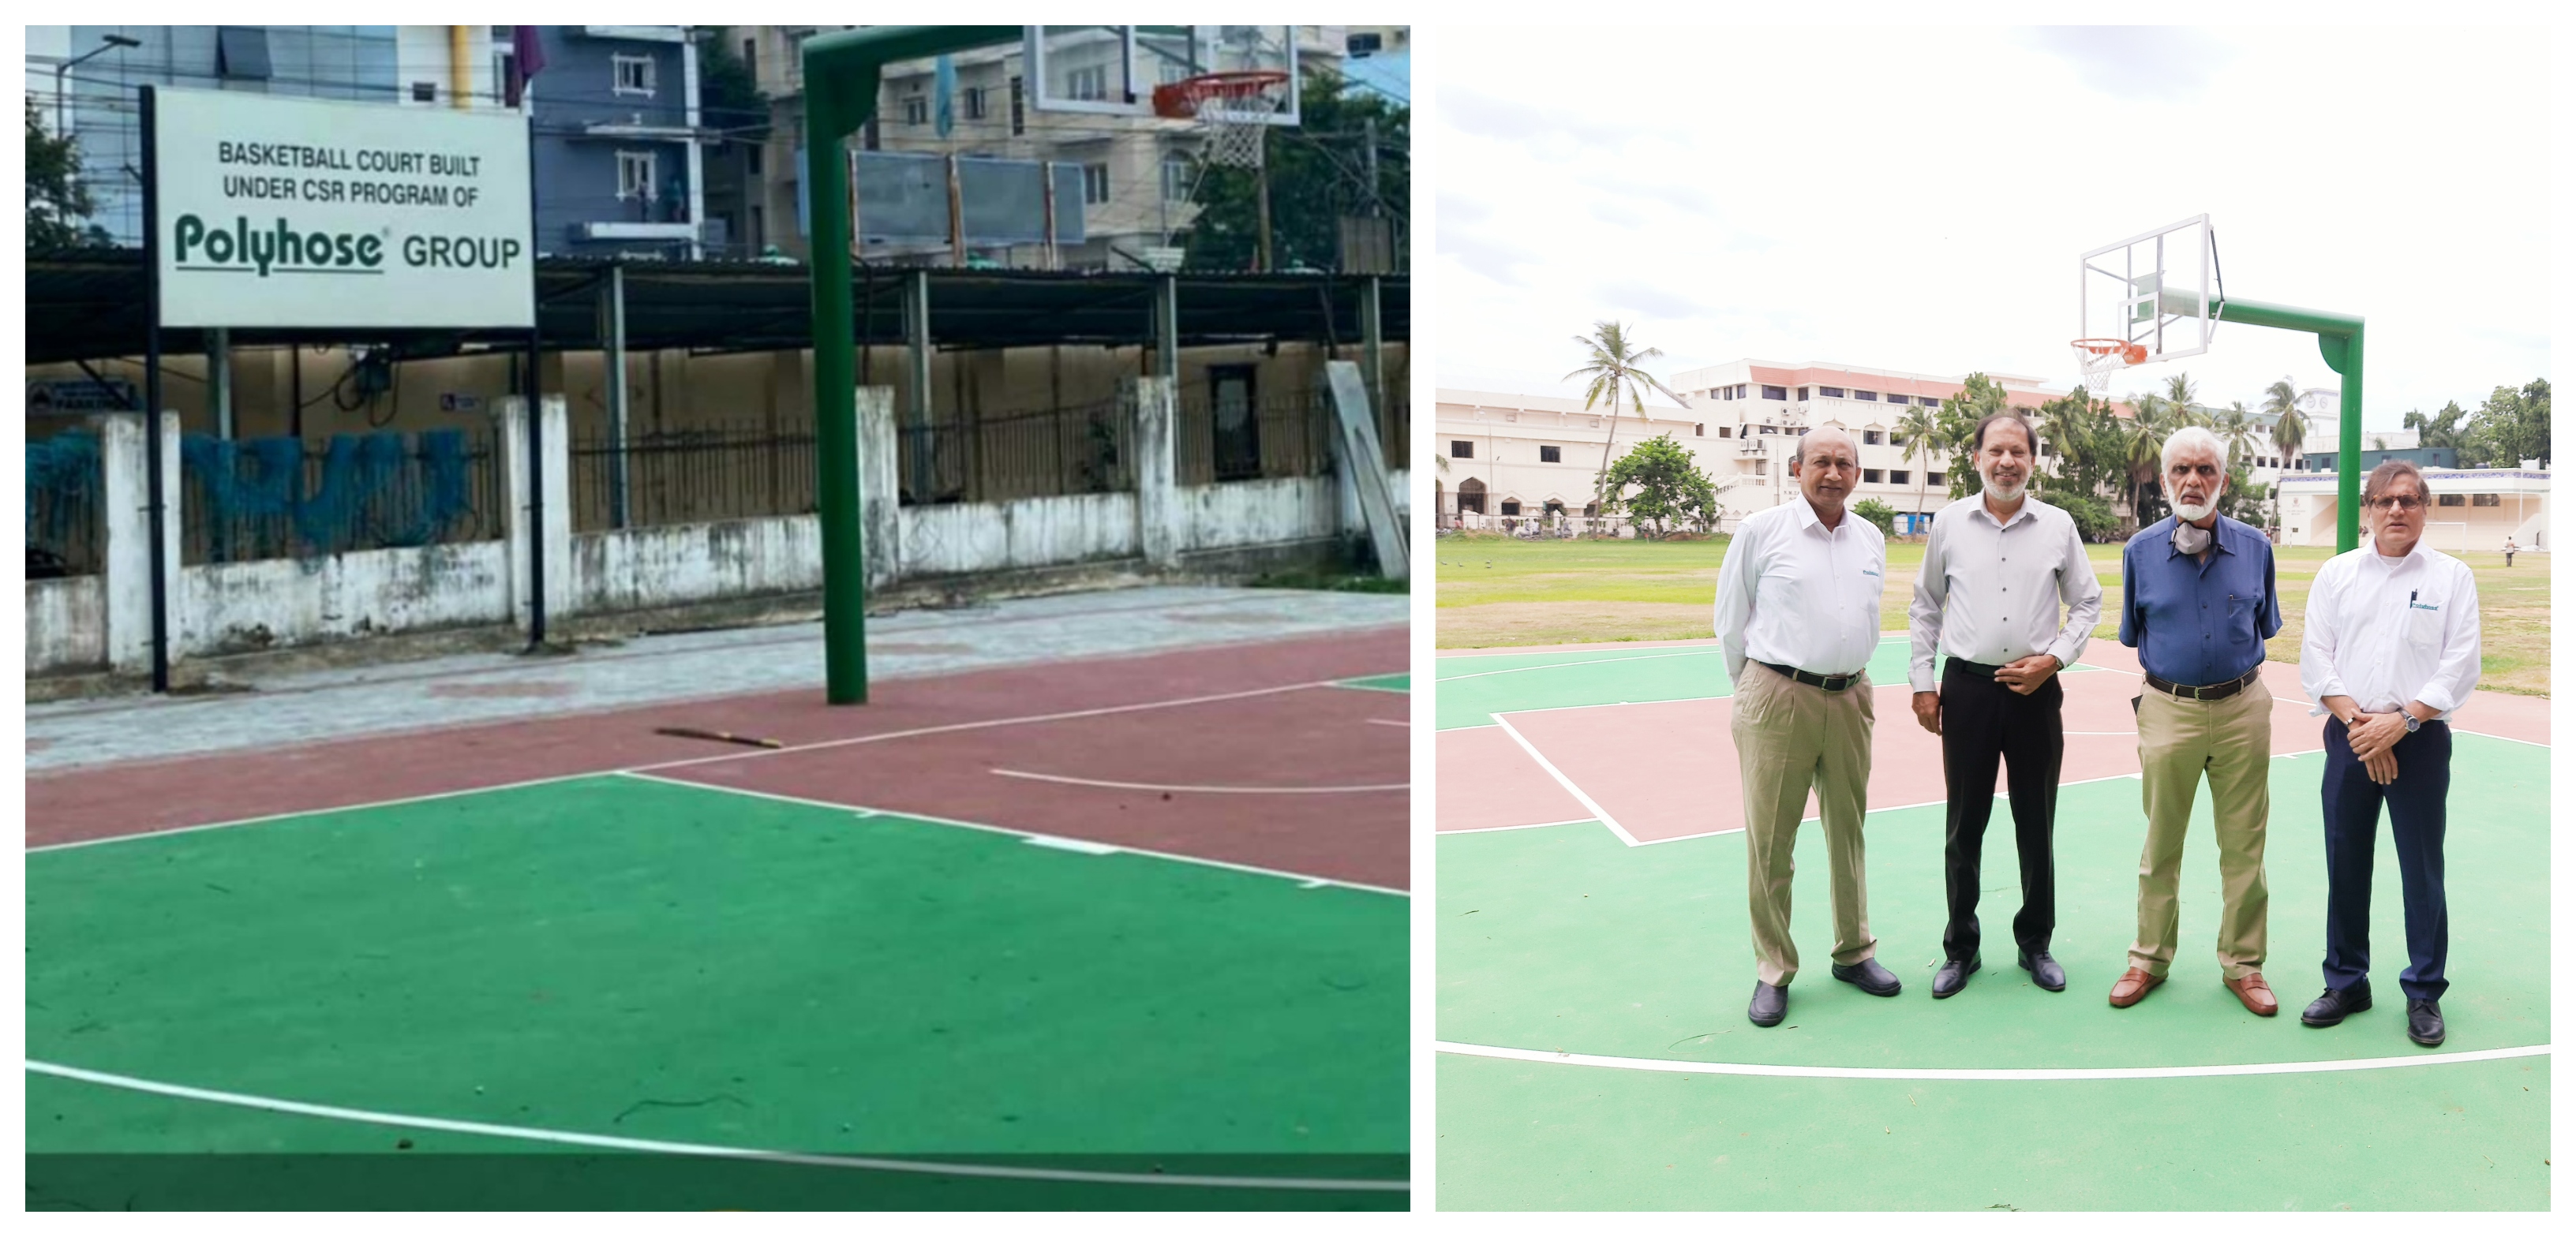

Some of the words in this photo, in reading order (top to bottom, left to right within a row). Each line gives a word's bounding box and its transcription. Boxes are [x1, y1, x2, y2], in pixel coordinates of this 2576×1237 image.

[219, 141, 352, 170] BASKETBALL
[357, 149, 425, 174] COURT
[429, 154, 480, 177] BUILT
[223, 175, 297, 200] UNDER
[302, 178, 345, 202] CSR
[350, 181, 448, 206] PROGRAM
[453, 186, 478, 207] OF
[174, 213, 384, 277] Polyhose
[402, 234, 521, 269] GROUP
